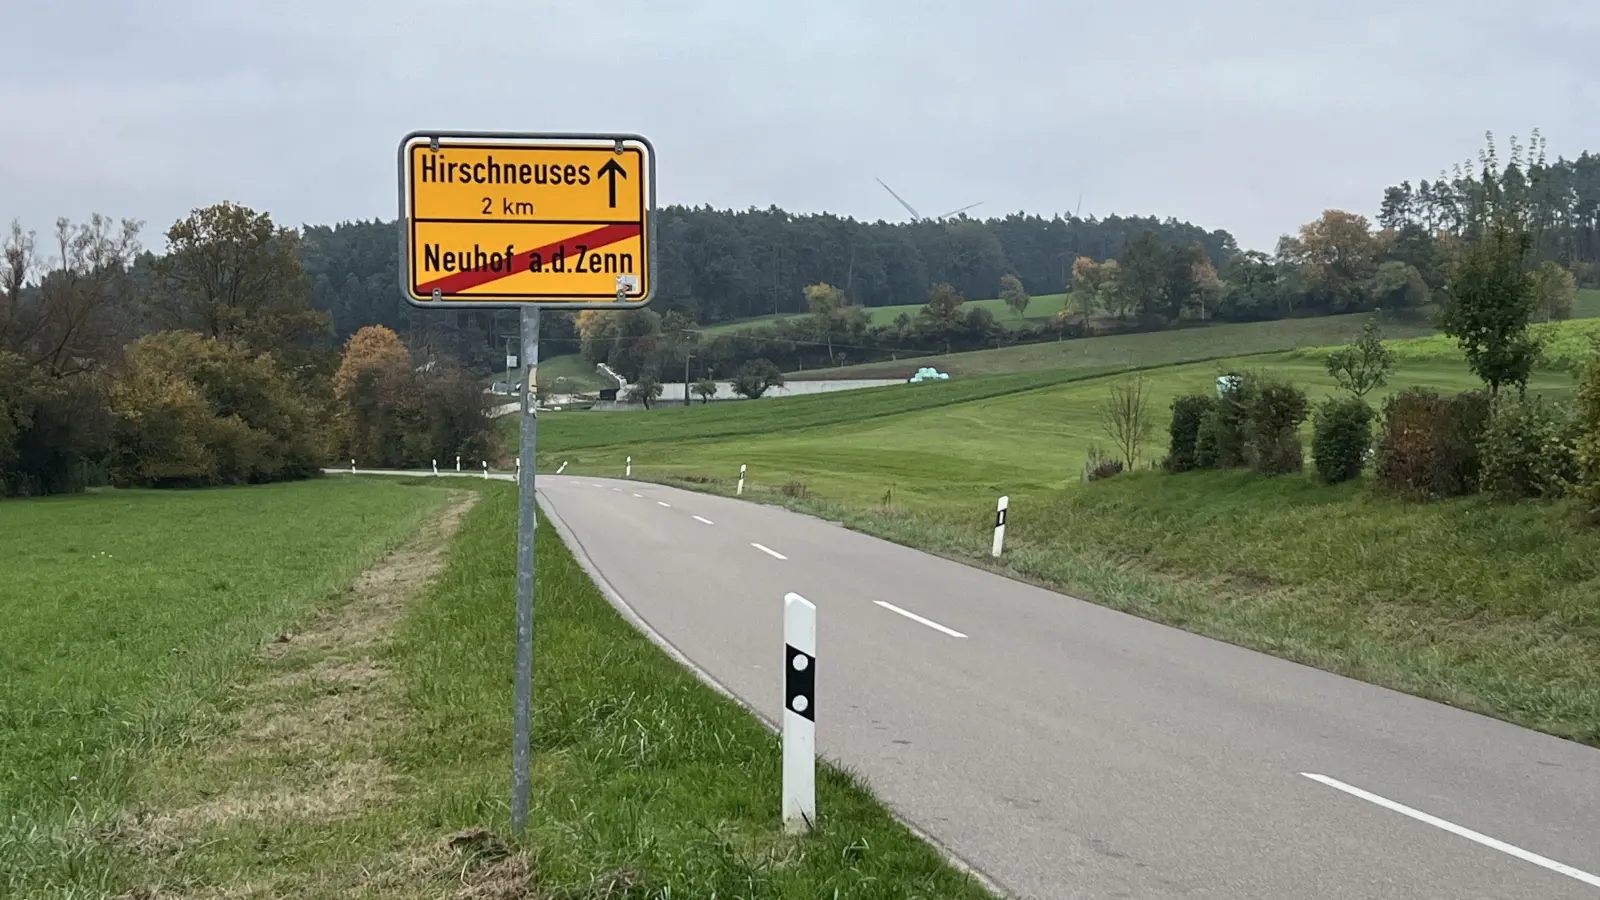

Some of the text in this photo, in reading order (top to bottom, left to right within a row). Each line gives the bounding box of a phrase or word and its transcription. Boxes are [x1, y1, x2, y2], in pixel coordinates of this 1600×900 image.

[421, 154, 591, 186] Hirschneuses
[481, 197, 534, 215] 2 km
[424, 243, 515, 273] Neuhof
